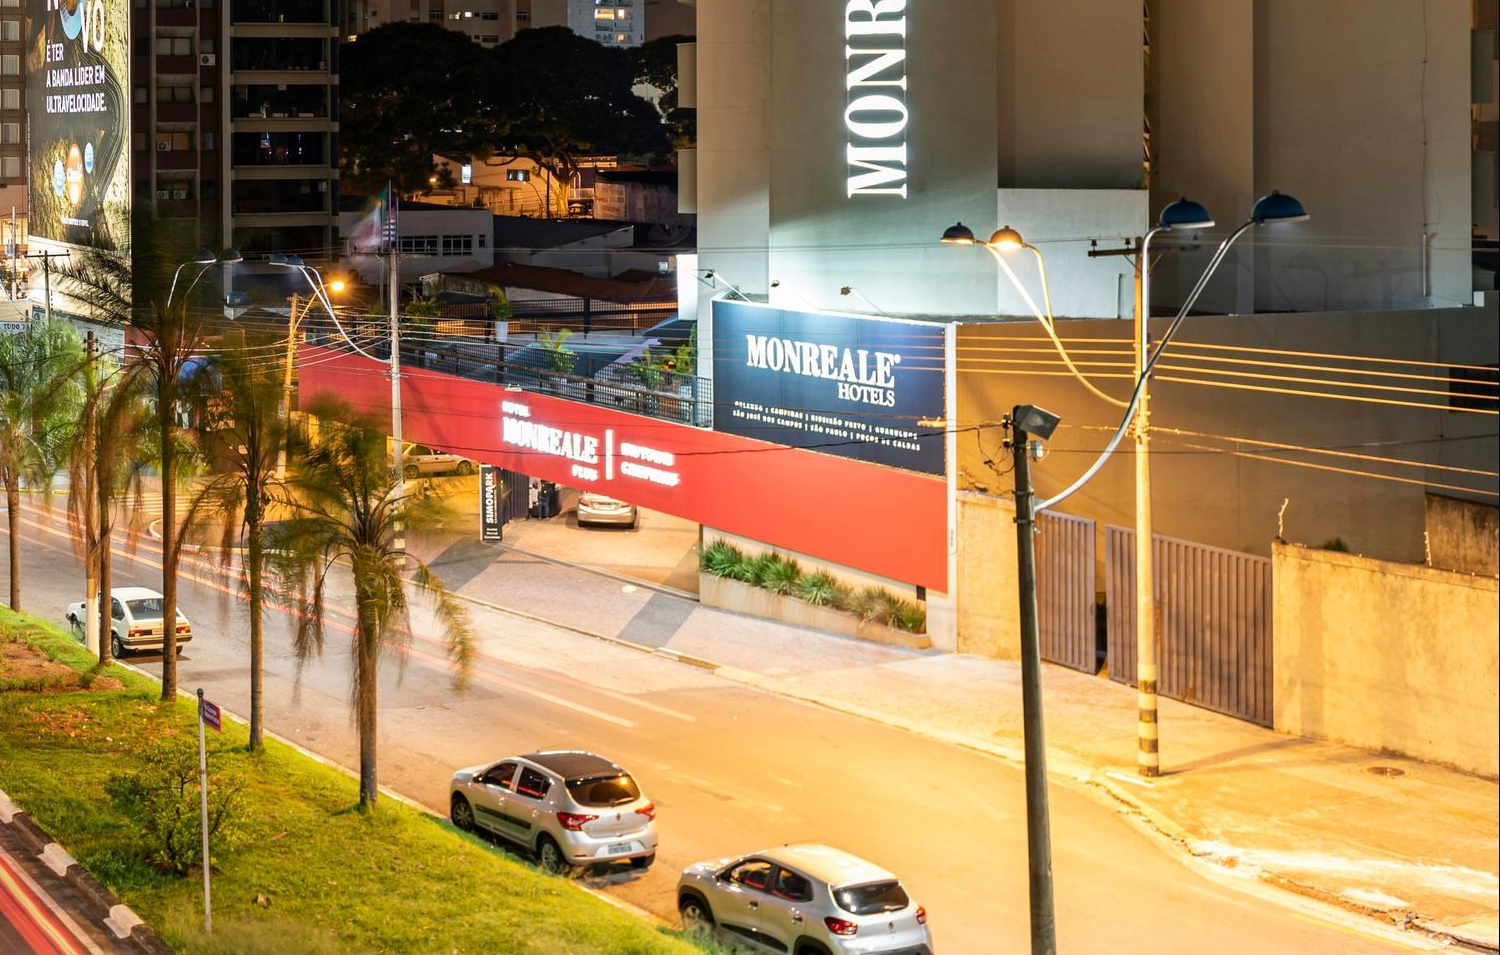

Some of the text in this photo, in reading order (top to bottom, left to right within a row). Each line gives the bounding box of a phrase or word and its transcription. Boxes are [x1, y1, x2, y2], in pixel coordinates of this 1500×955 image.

[46, 39, 64, 63] É TER
[46, 61, 105, 88] A BANDA LÍDER EM
[46, 92, 107, 113] ULTRAVELOCIDADE.
[837, 381, 896, 408] HOTELS
[770, 407, 804, 420] CAMPINAS
[502, 416, 599, 464] MONREALE
[732, 409, 745, 418] SÃO
[762, 415, 775, 424] DOS
[776, 418, 803, 429] CAMPOS
[810, 424, 824, 434] SÃO
[825, 427, 848, 438] PAULO
[892, 440, 921, 452] CALDAS
[485, 472, 495, 524] SIMOPARK
